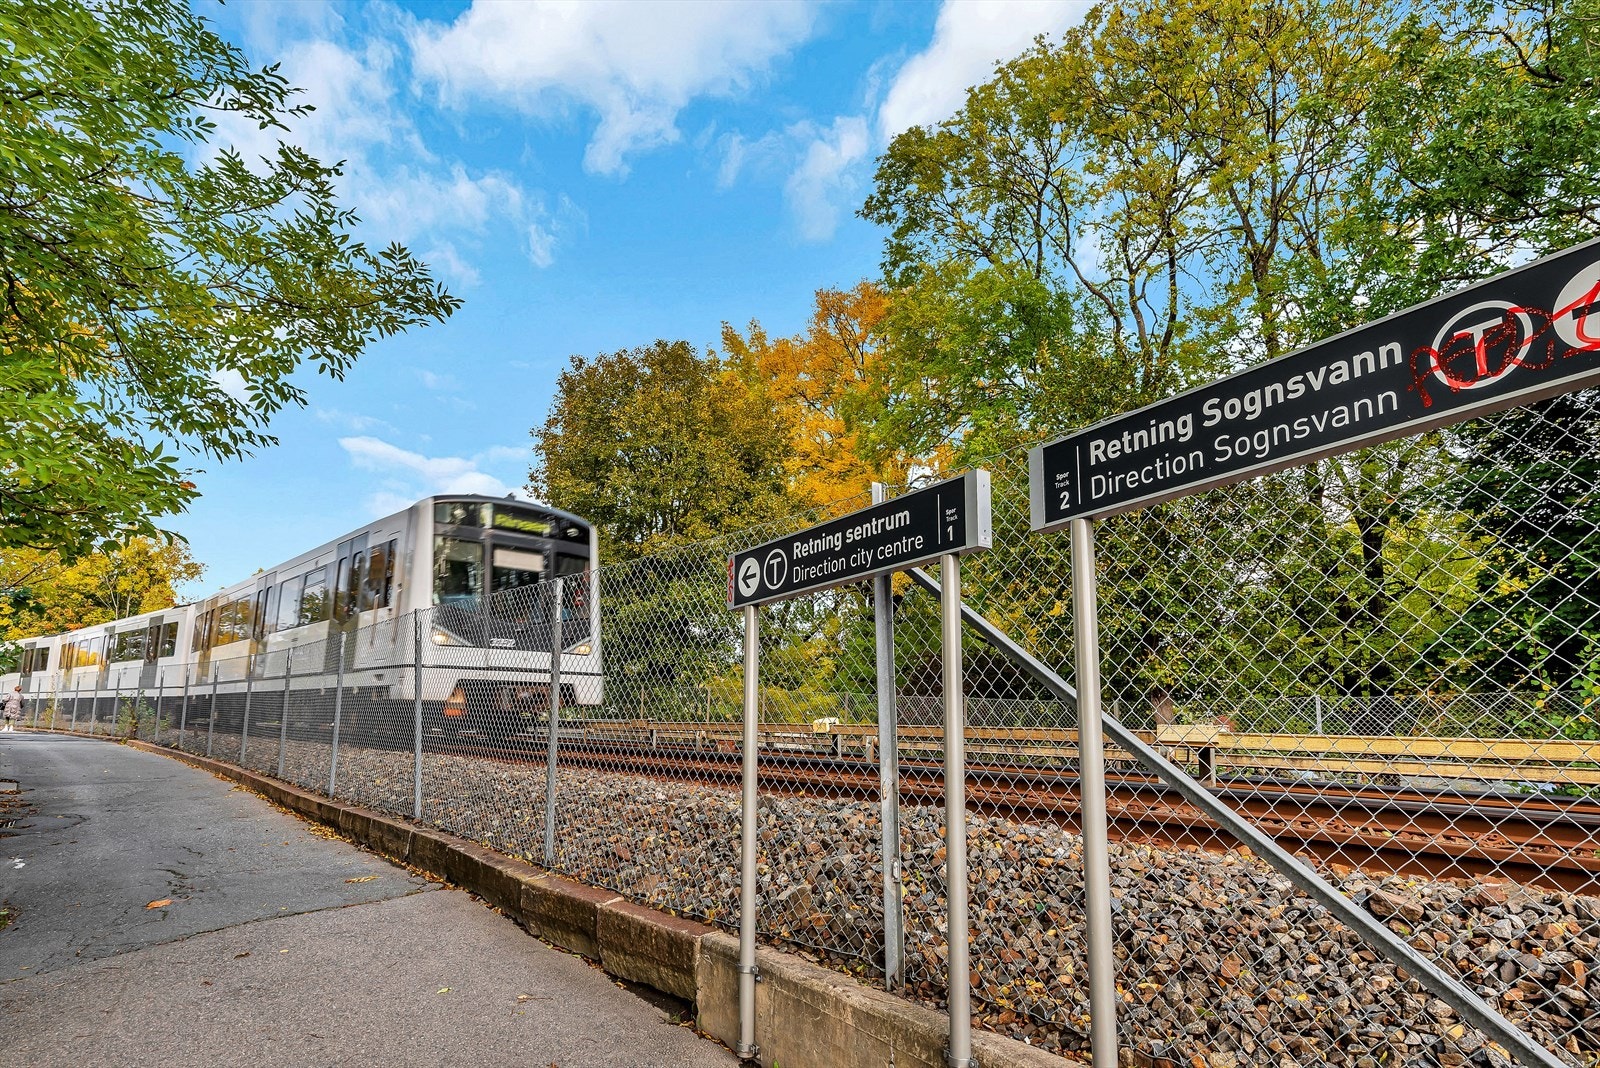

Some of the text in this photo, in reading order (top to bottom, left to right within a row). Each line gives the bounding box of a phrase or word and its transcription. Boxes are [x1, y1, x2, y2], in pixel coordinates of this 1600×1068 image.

[1090, 410, 1193, 466] Retning
[1202, 341, 1403, 427] Sognsvann
[1091, 391, 1398, 499] Direction Sognsvann
[1055, 480, 1070, 488] Track
[1056, 472, 1070, 480] Spor
[1060, 491, 1070, 510] 2
[794, 510, 910, 560] Retning sentrum
[948, 526, 953, 541] 1
[793, 535, 924, 583] Direction city centre
